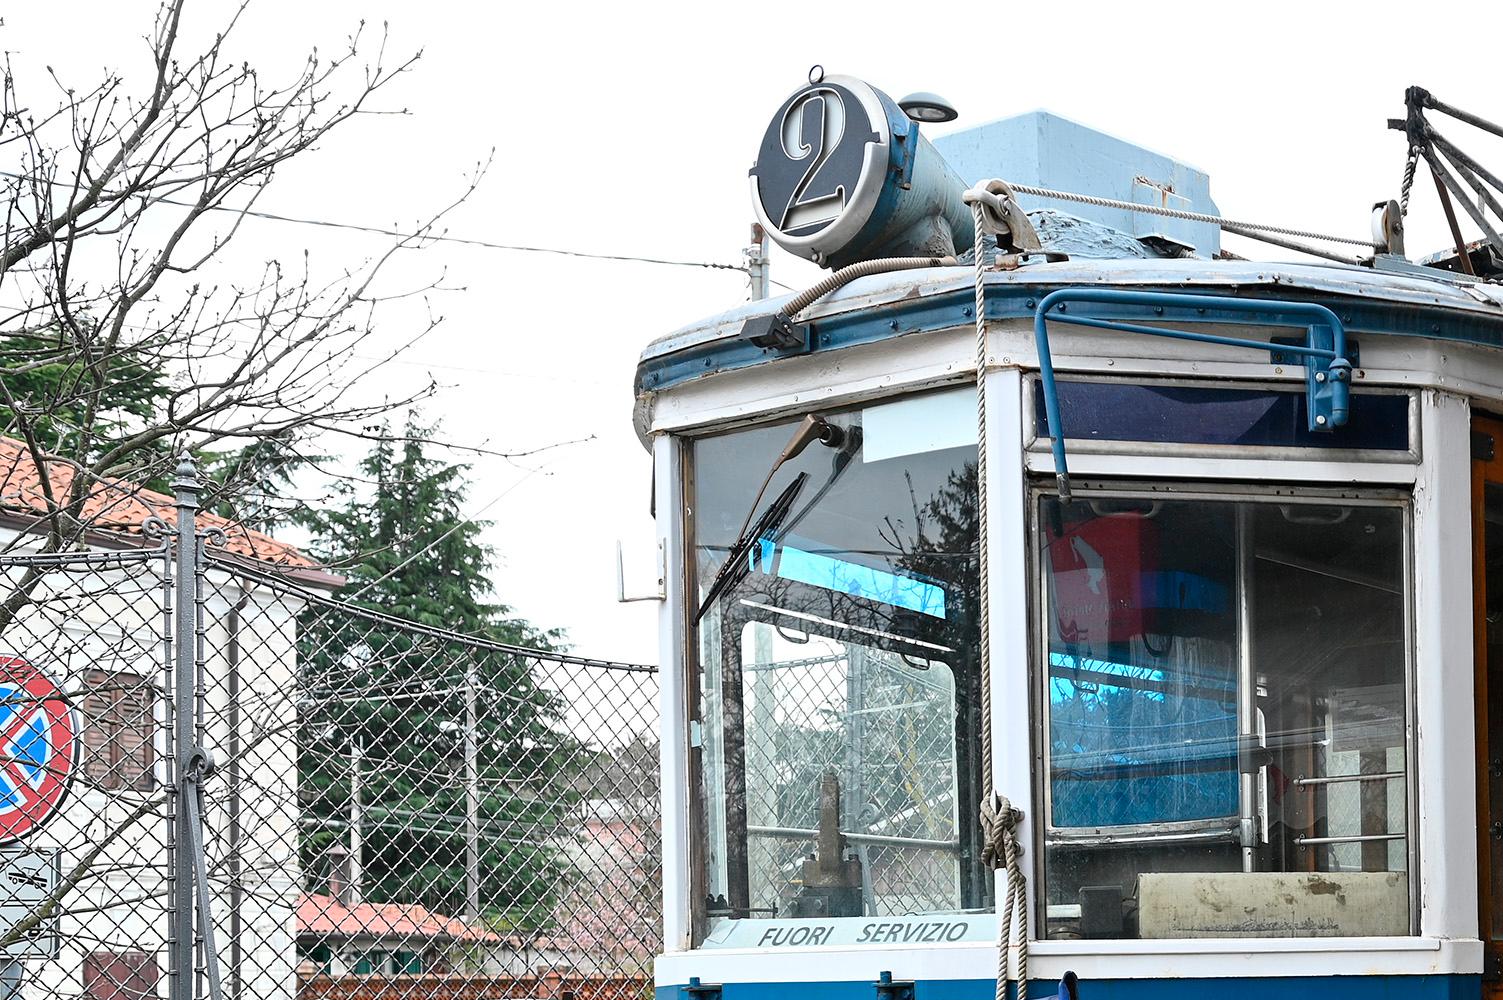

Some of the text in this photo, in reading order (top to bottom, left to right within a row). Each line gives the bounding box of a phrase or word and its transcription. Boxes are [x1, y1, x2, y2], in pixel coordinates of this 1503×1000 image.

[779, 87, 846, 232] 2
[758, 922, 969, 947] FUORI SERVIZIO
